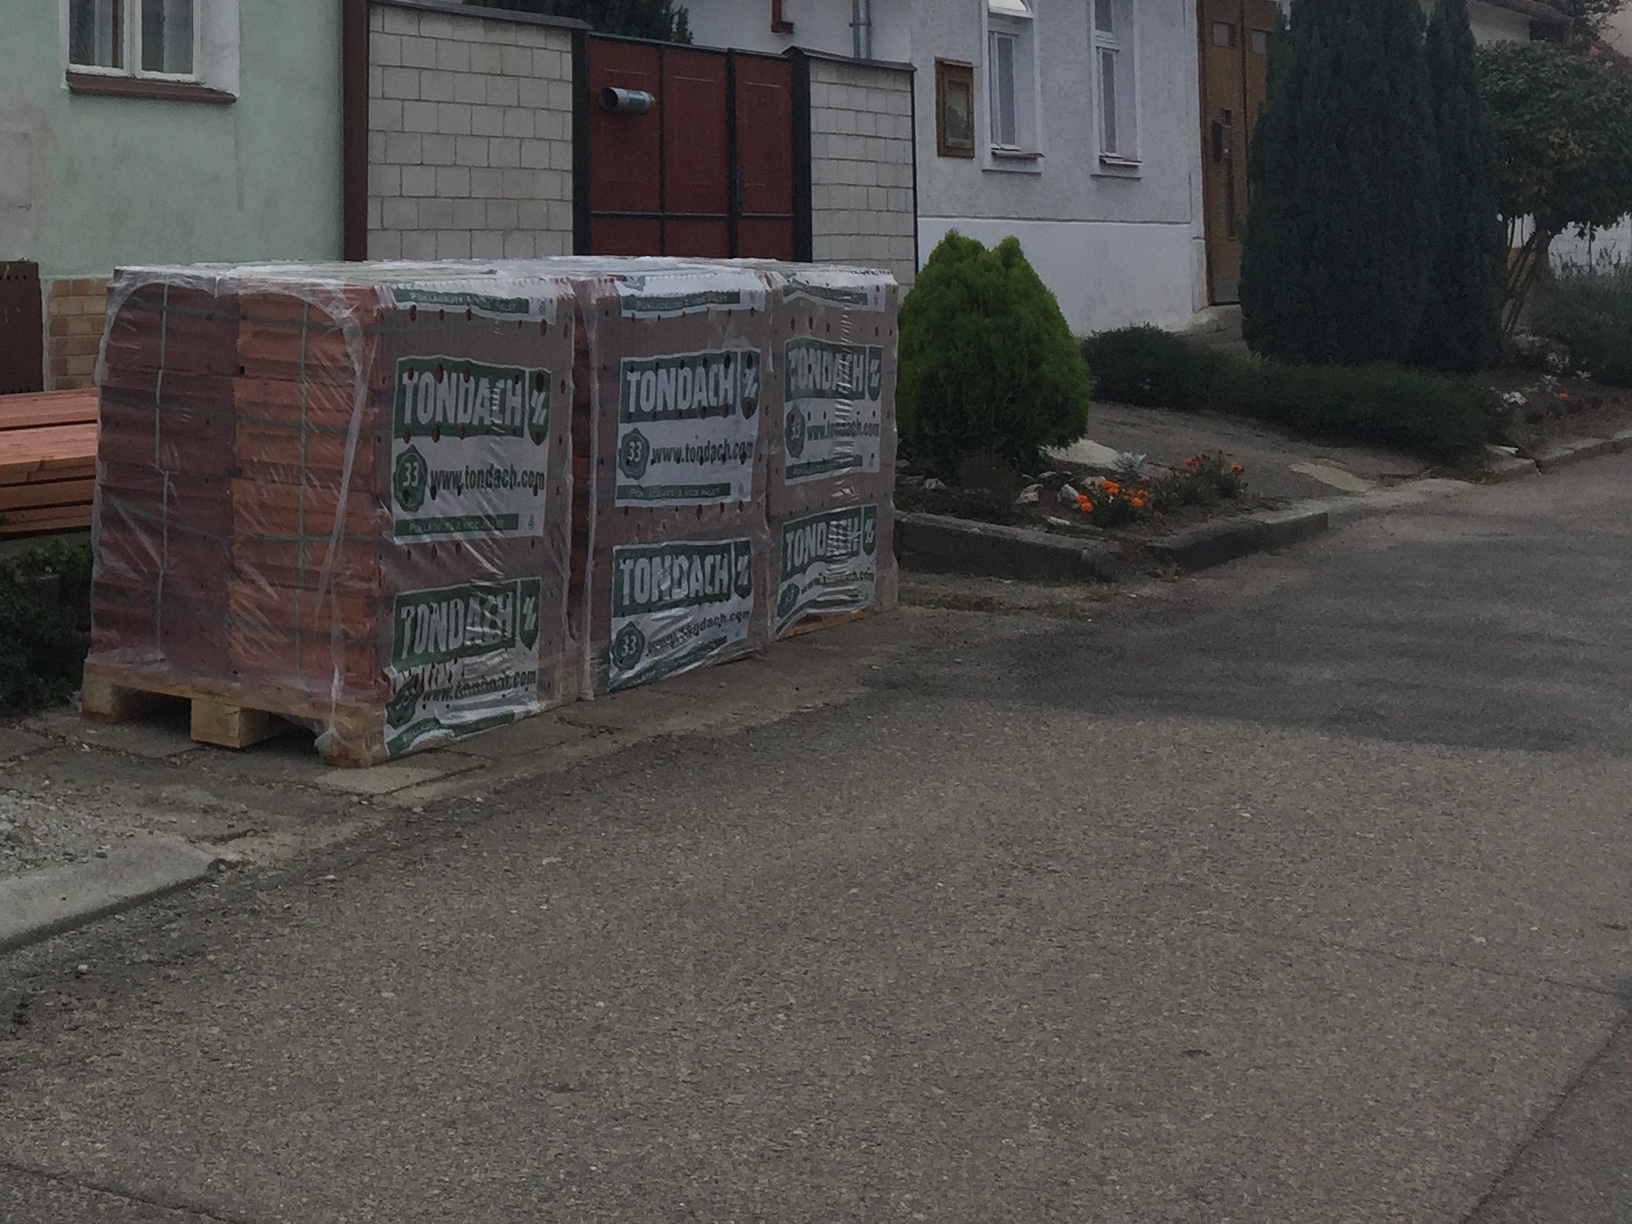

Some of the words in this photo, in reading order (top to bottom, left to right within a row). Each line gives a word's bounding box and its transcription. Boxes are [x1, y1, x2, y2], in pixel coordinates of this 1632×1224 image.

[626, 361, 735, 413] TONDACH
[788, 348, 864, 393] TONDACH
[402, 370, 522, 426] TONDACH
[403, 462, 419, 487] 33
[627, 441, 642, 462] 33
[430, 464, 545, 491] www.tondach.com
[785, 517, 859, 572] TONDACH
[619, 553, 728, 606] TONDACH
[401, 591, 513, 659] TONDACH
[621, 635, 637, 657] 33
